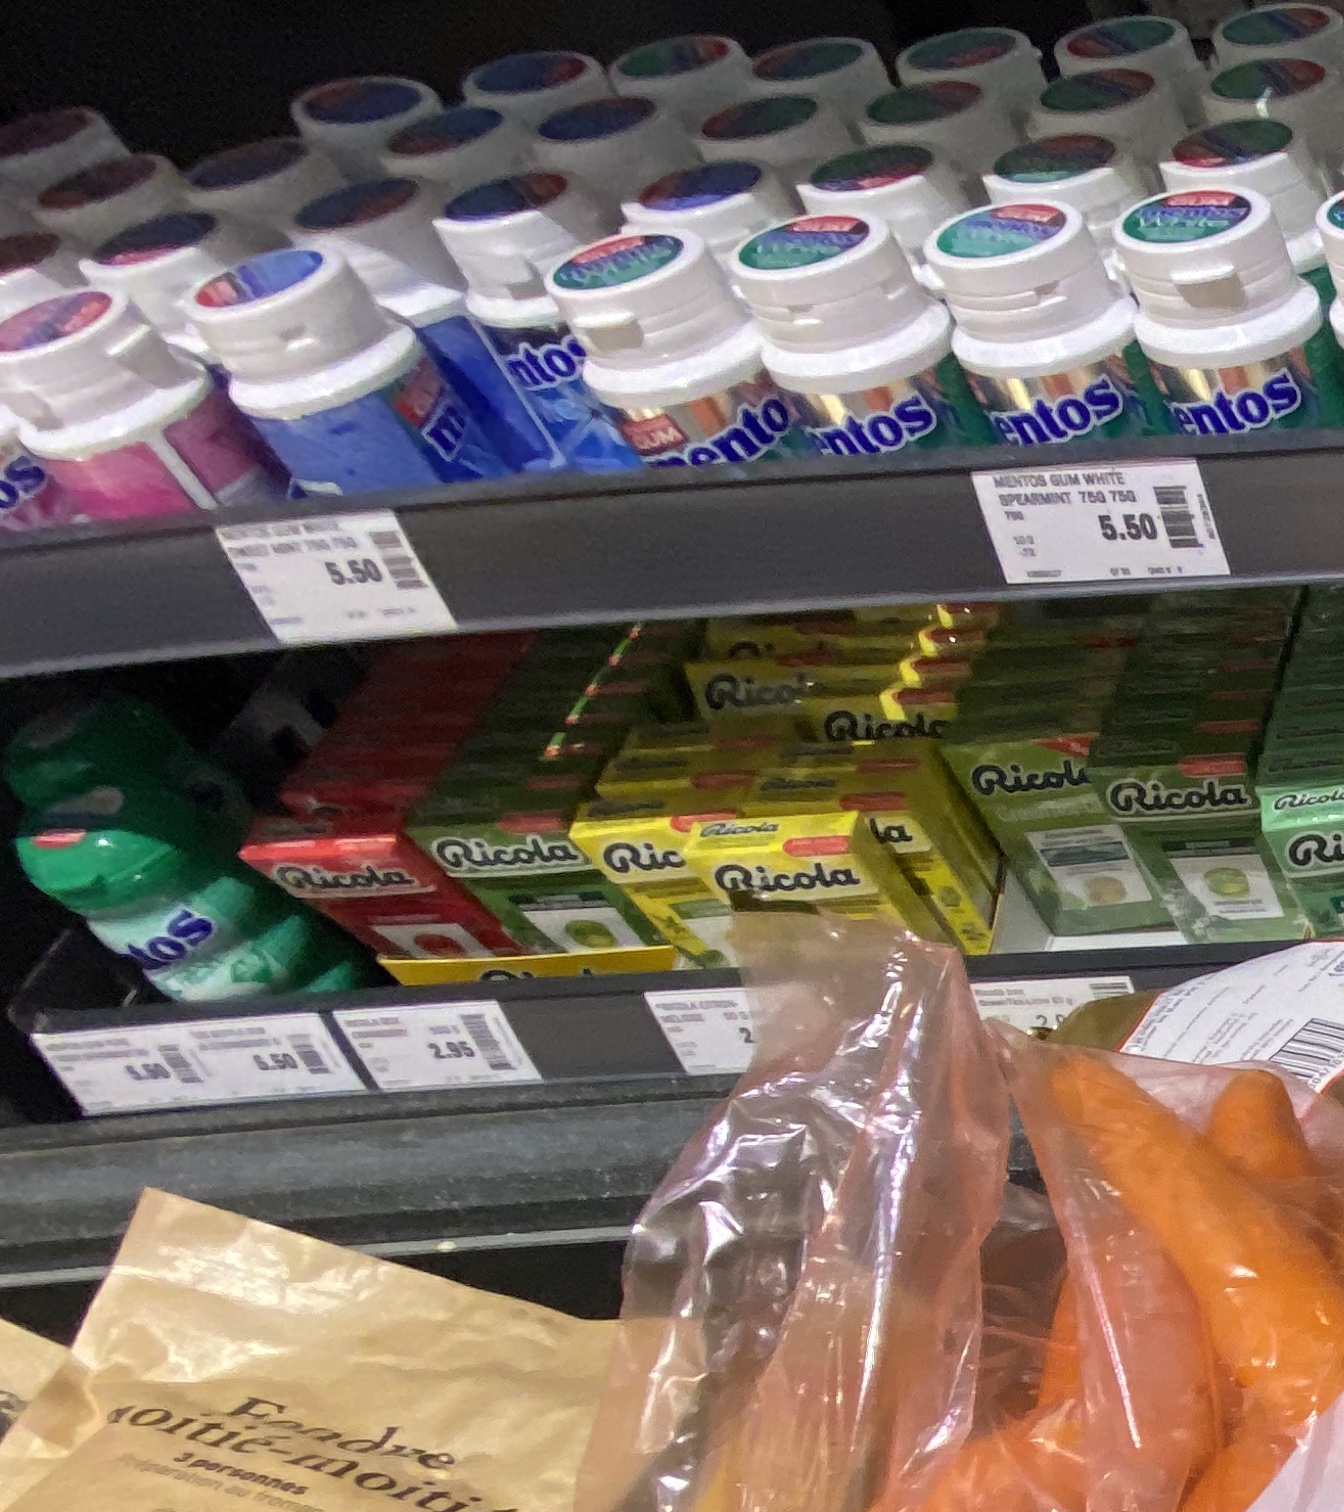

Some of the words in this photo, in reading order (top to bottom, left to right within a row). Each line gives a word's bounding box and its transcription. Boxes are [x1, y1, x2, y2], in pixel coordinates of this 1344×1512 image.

[992, 473, 1047, 488] MENTOS
[1050, 472, 1081, 487] GUM
[1083, 471, 1126, 486] WHITE
[1097, 513, 1159, 542] 5.50
[325, 557, 383, 586] 5.50
[1110, 782, 1250, 814] Ricola
[437, 838, 578, 868] Ricola
[273, 865, 414, 891] Ricola
[716, 862, 861, 895] Ricola
[172, 1451, 191, 1464] 3
[188, 1458, 310, 1496] personnes
